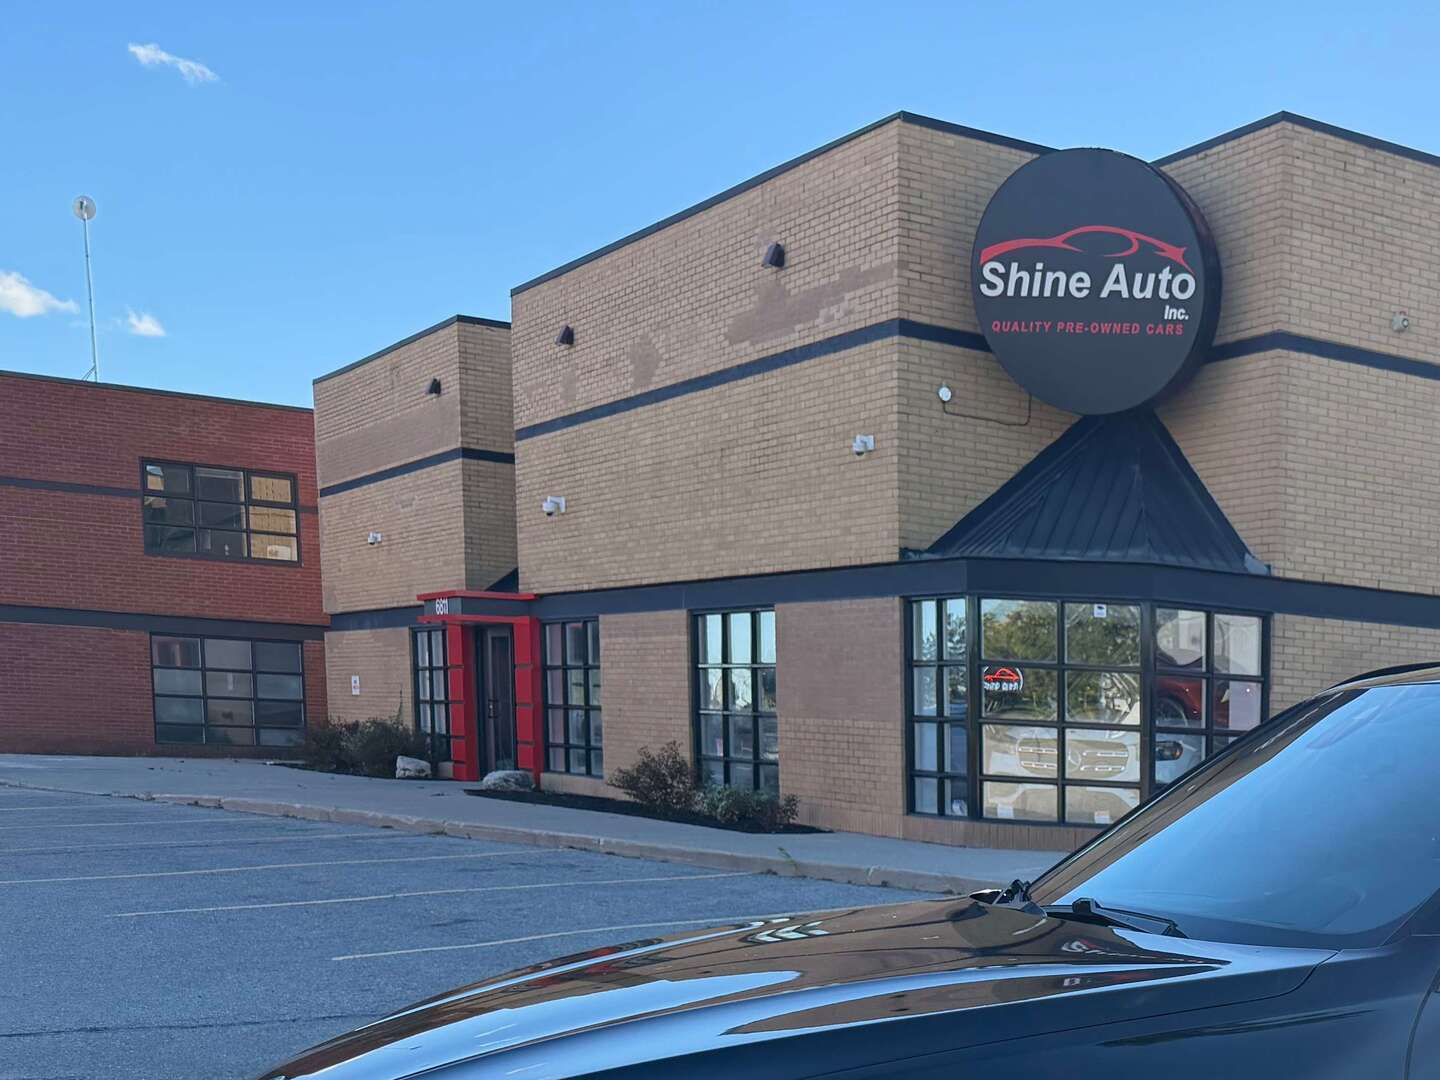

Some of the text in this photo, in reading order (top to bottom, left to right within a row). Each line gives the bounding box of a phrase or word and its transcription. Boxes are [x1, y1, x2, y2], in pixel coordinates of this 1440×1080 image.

[980, 261, 1196, 300] Shine Auto
[1164, 305, 1189, 320] Inc.
[991, 320, 1184, 335] QUALITY PRE-OWNED CARS
